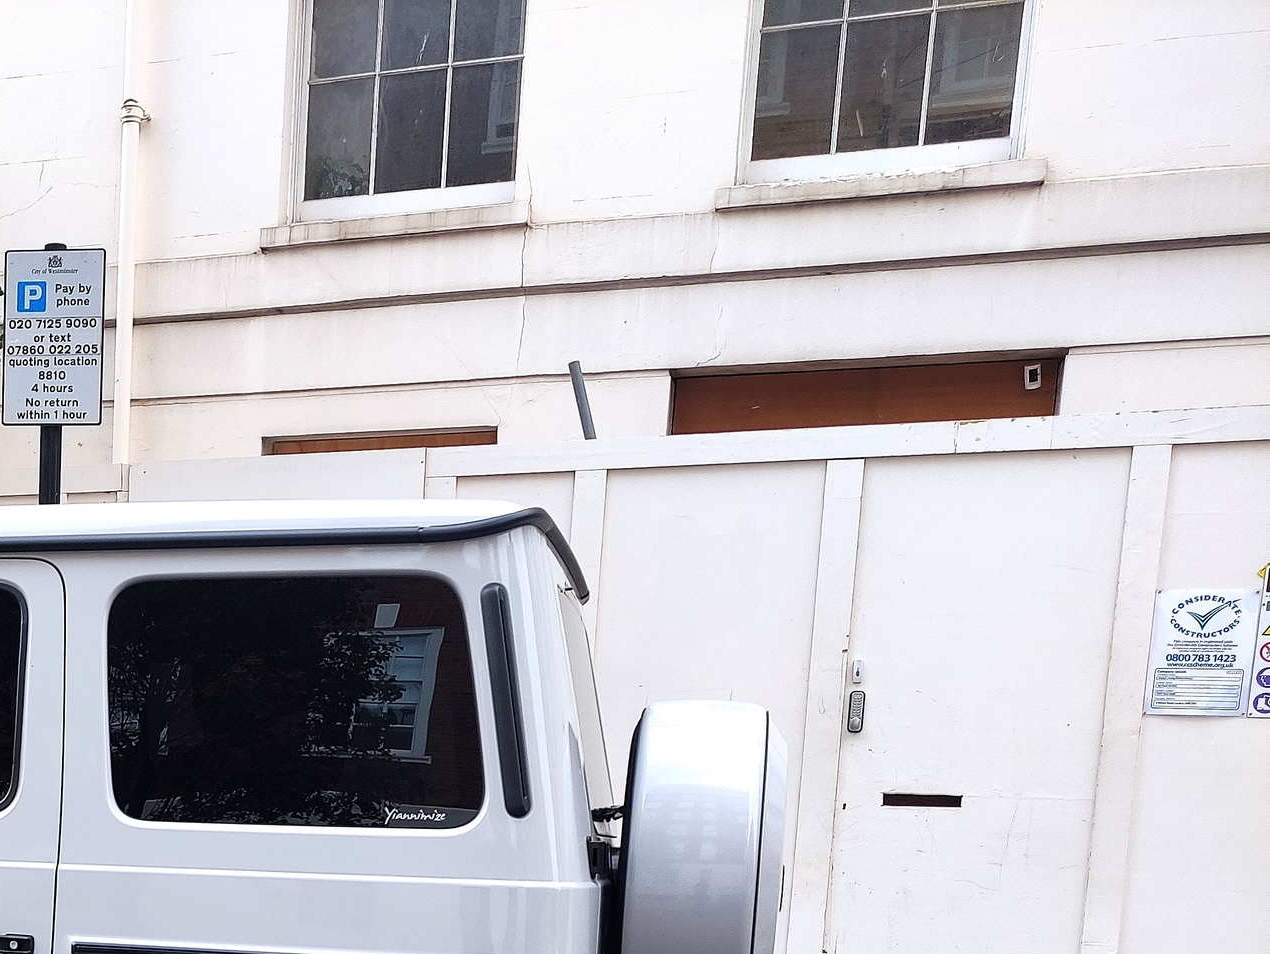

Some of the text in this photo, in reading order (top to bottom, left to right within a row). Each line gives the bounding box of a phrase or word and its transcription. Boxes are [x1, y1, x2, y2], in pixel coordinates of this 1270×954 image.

[55, 283, 92, 295] Pay by
[24, 285, 43, 310] P
[56, 297, 90, 308] phone
[9, 318, 97, 329] 020 7125 9090
[49, 333, 71, 342] text
[7, 344, 98, 355] 07860 022 205
[9, 356, 97, 368] quoting location
[38, 371, 66, 380] 8810
[31, 383, 73, 393] 4 hours
[25, 398, 79, 407] No return
[17, 410, 87, 419] within 1 hour
[1172, 595, 1242, 616] CONSIDERATE
[1170, 618, 1240, 639] CONSTRUCTORS
[1165, 653, 1237, 663] 0800 783 1423
[384, 806, 446, 825] Yiannimize
